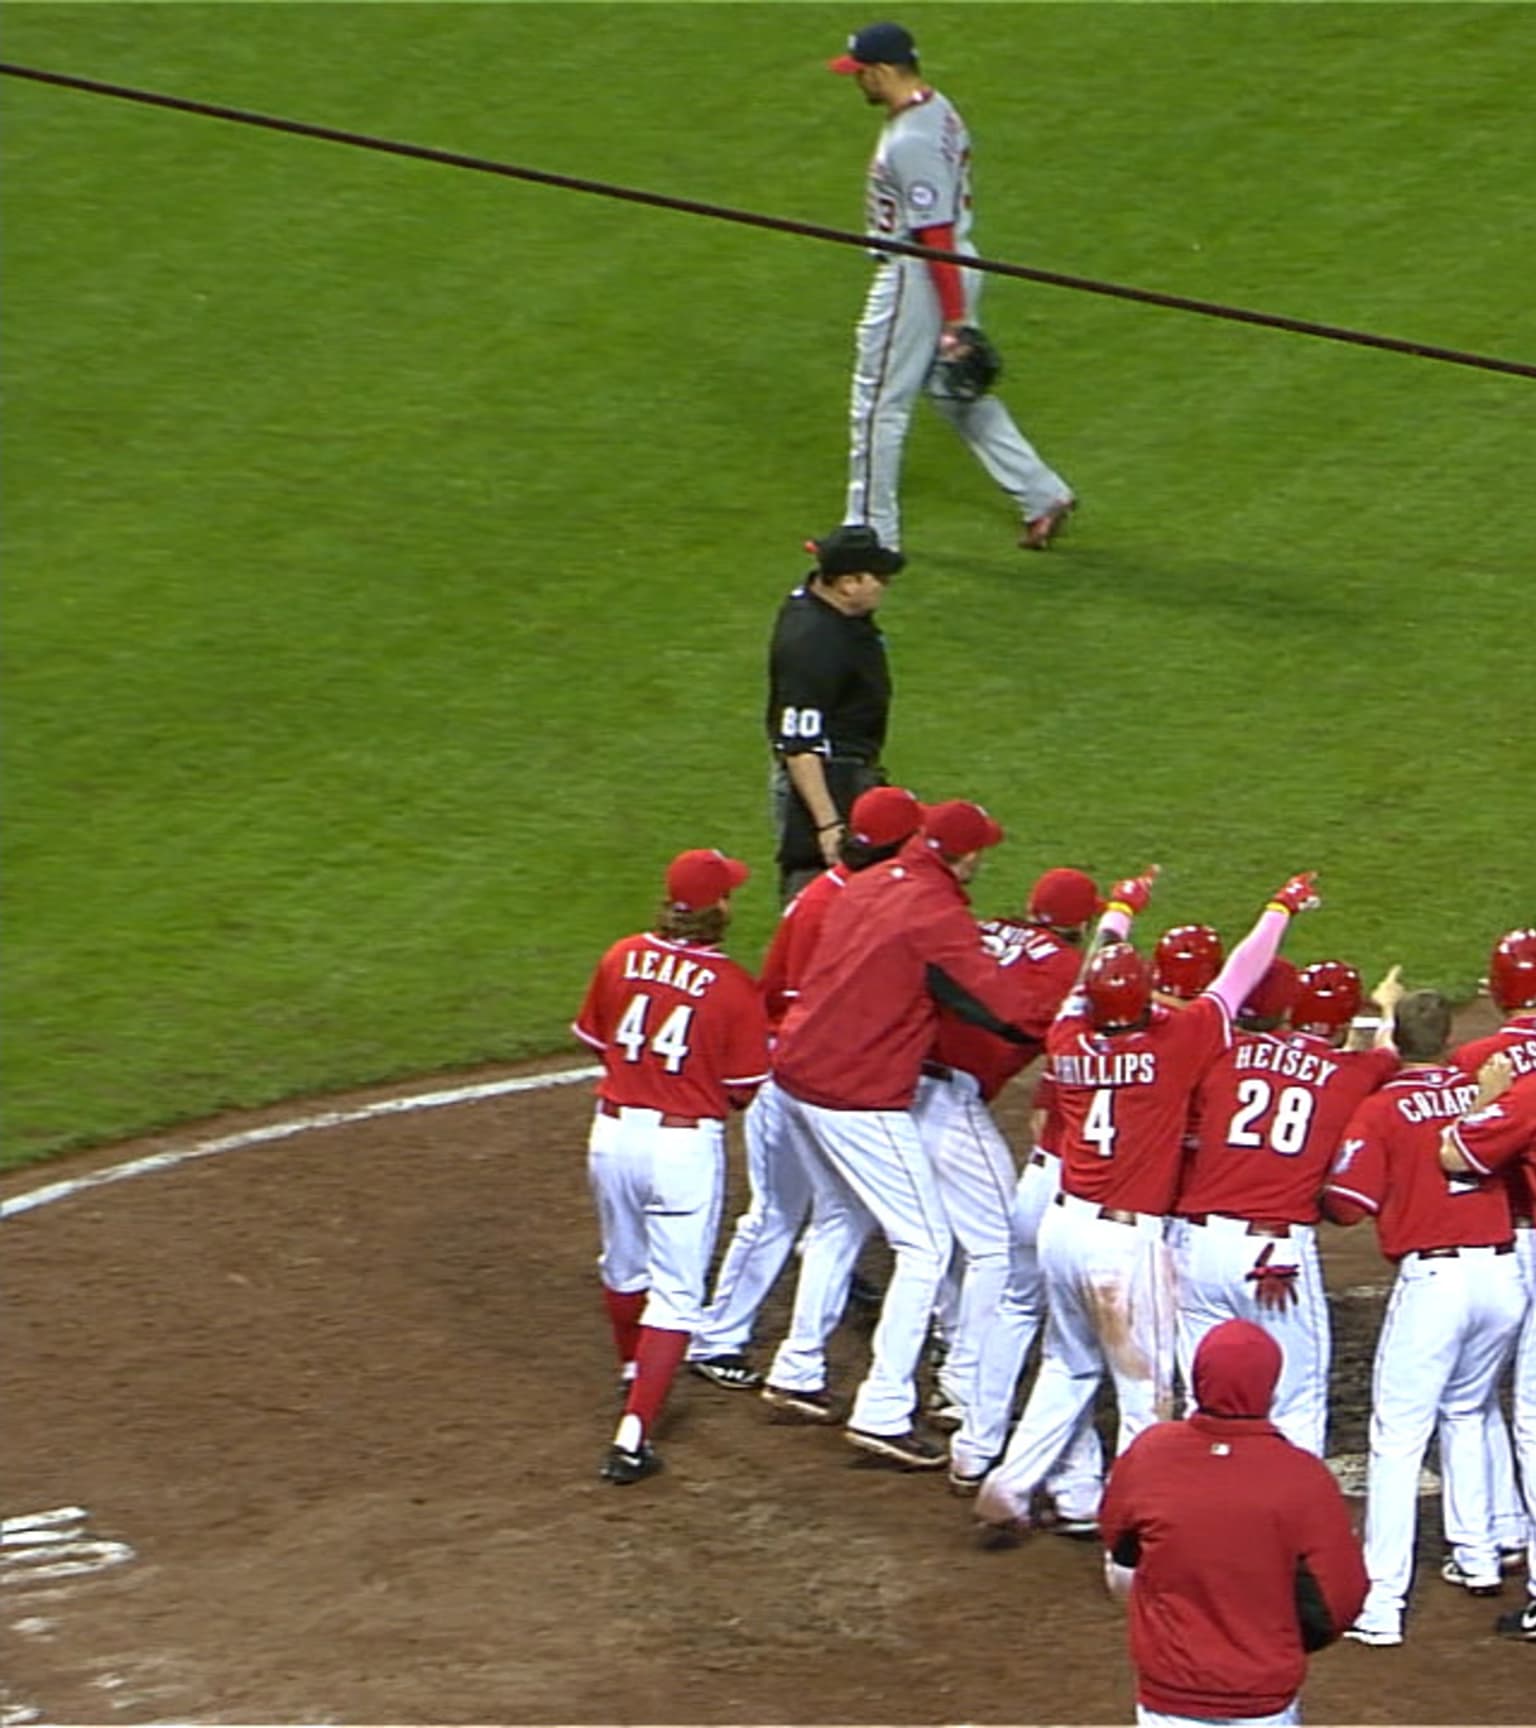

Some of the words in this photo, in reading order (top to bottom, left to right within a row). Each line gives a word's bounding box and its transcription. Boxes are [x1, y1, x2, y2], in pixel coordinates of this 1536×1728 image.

[623, 949, 718, 998] LEAKE
[614, 993, 694, 1074] 44
[1235, 1042, 1339, 1087] HEISEY
[1082, 1088, 1117, 1157] 4
[1226, 1078, 1314, 1154] 28
